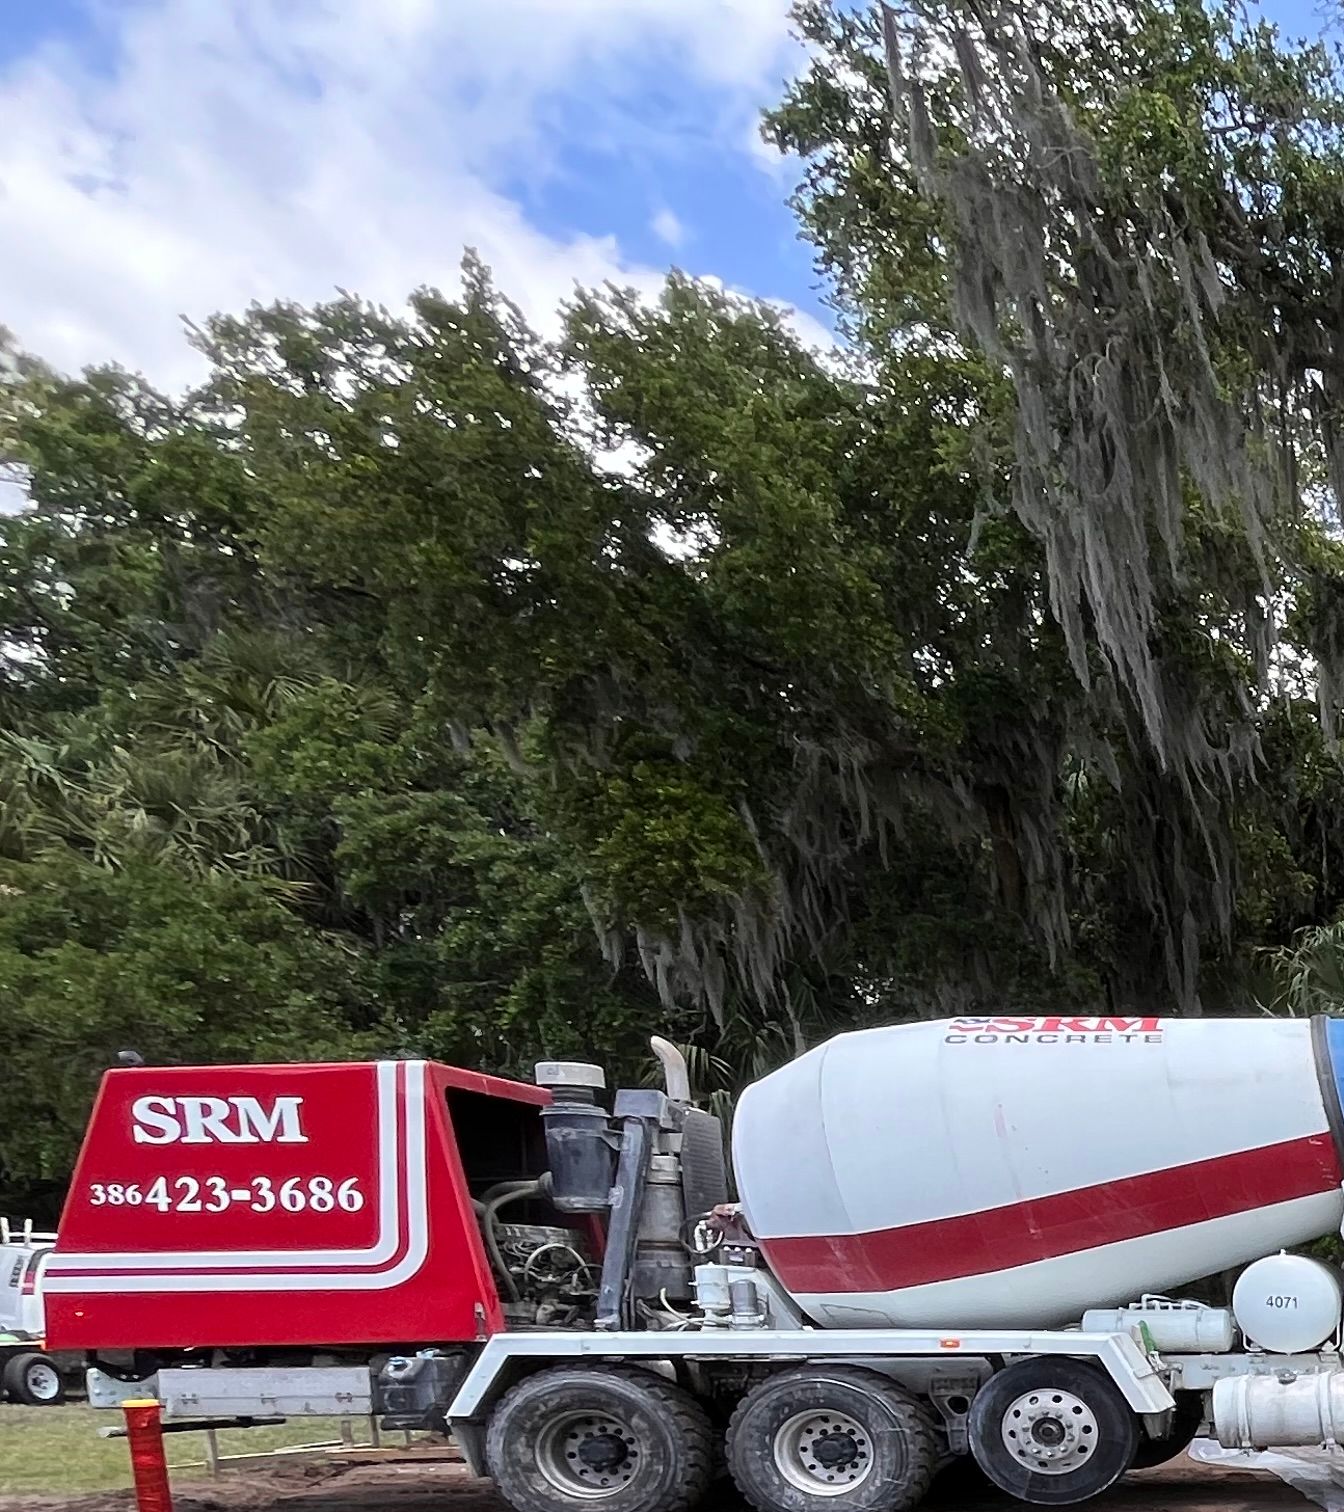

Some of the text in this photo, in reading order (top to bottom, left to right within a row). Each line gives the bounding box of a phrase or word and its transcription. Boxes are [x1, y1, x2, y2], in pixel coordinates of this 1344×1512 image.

[945, 1034, 1163, 1043] CONCRETE
[132, 1096, 308, 1144] SRM
[1266, 1295, 1298, 1309] 4071
